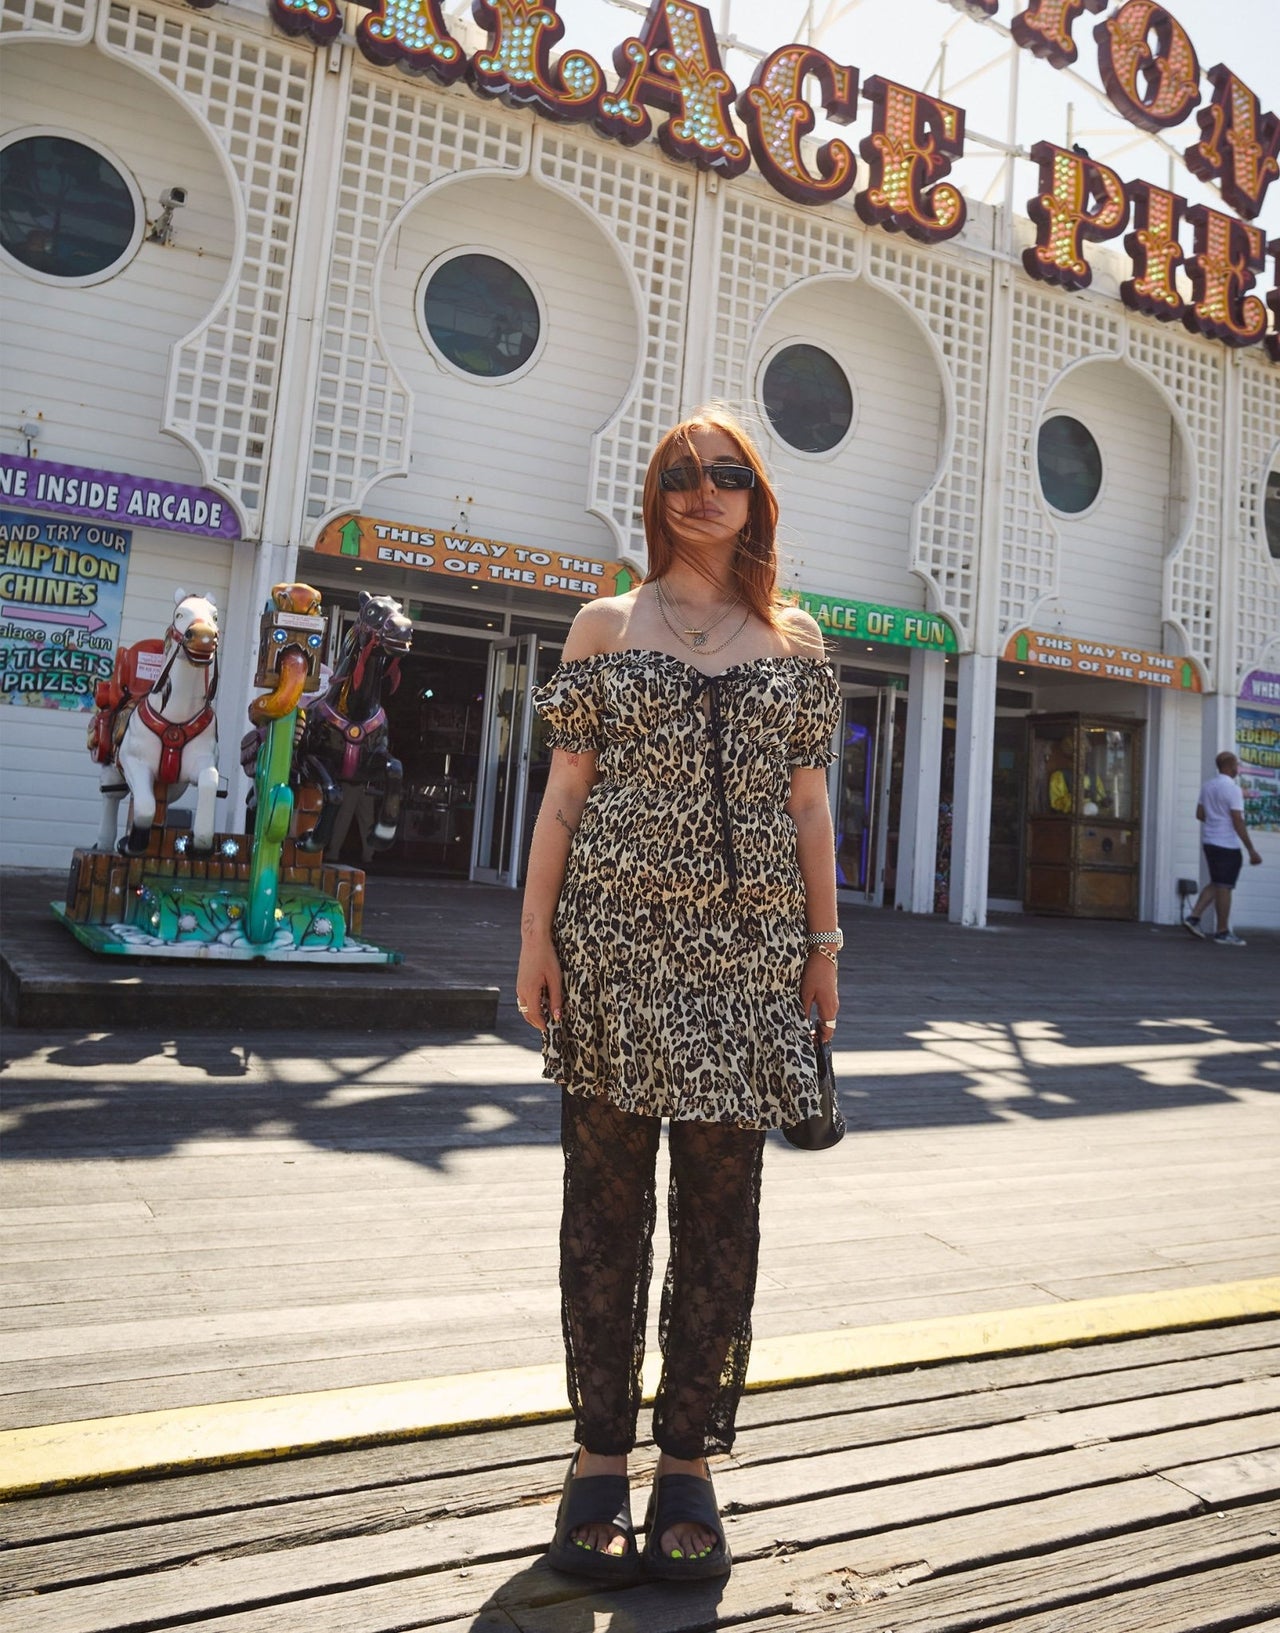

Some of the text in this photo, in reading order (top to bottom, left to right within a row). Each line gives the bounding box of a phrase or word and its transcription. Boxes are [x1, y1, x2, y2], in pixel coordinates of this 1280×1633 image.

[1022, 140, 1280, 361] PIE
[36, 473, 120, 512] INSIDE
[127, 489, 223, 528] ARCADE
[46, 524, 82, 541] TRY
[87, 527, 126, 553] OUR
[374, 524, 605, 576] THIS WAY TO THE
[377, 547, 598, 595] END OF THE PIER
[51, 628, 74, 648] of
[77, 630, 112, 650] Fun
[867, 611, 895, 635] OF
[904, 617, 946, 644] FUN
[13, 649, 113, 677] TICKETS
[1035, 635, 1175, 670] THIS WAY TO THE
[1038, 653, 1172, 685] END OF THE PIER
[3, 672, 89, 695] PRIZES
